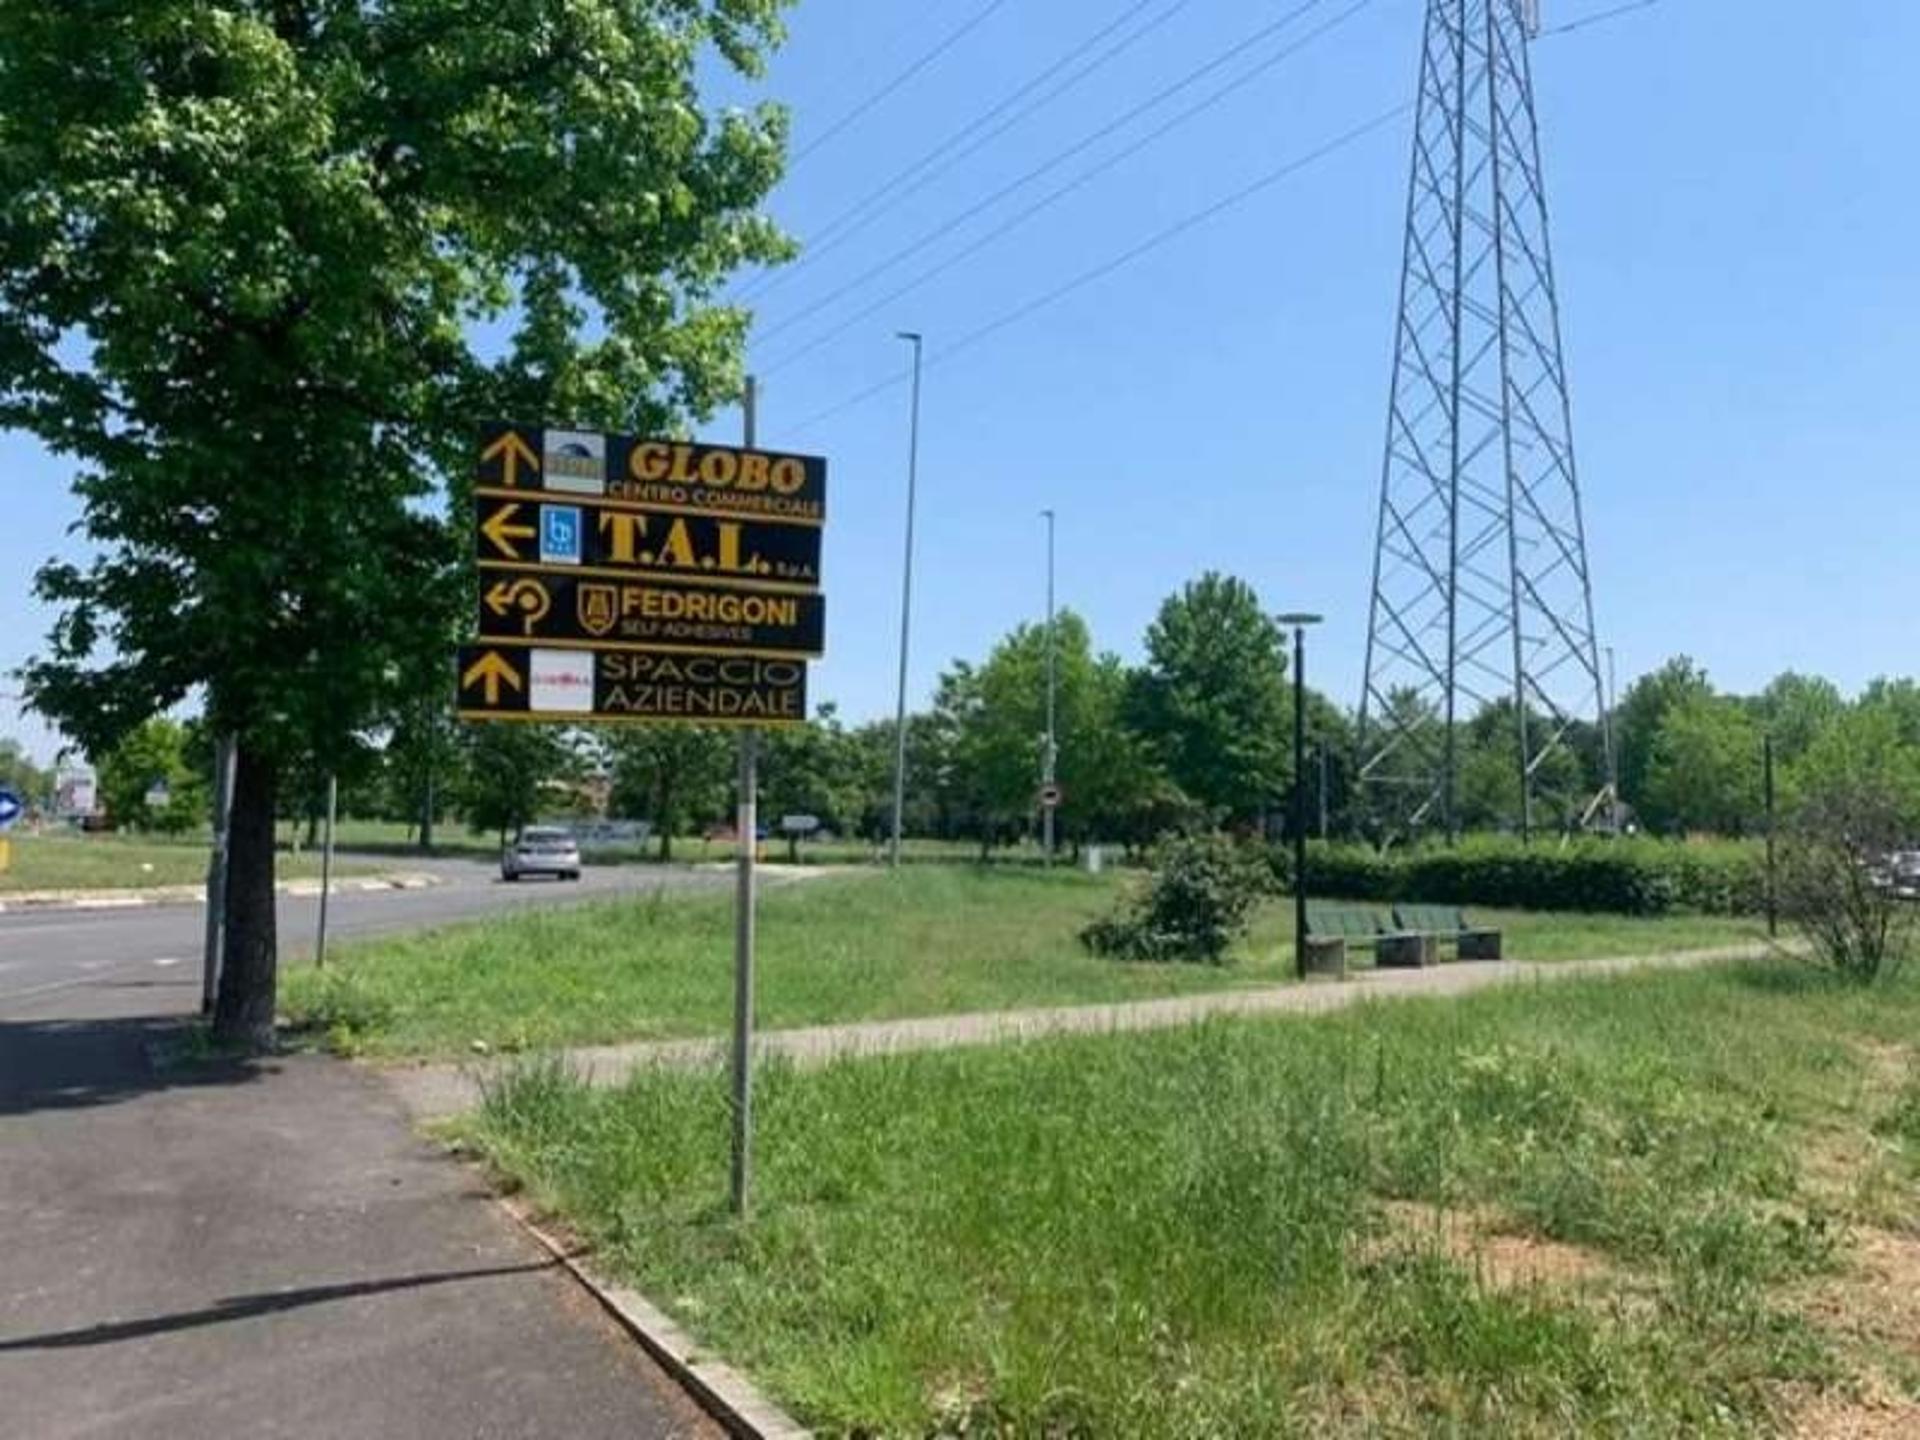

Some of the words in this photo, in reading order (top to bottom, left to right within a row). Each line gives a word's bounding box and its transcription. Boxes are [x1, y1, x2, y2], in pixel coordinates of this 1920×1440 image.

[630, 442, 806, 495] GLOBO
[608, 480, 688, 503] CENTRO
[622, 586, 798, 625] FEDRIGONI
[603, 652, 800, 686] SPACCIO
[603, 682, 798, 714] AZIENDALE
